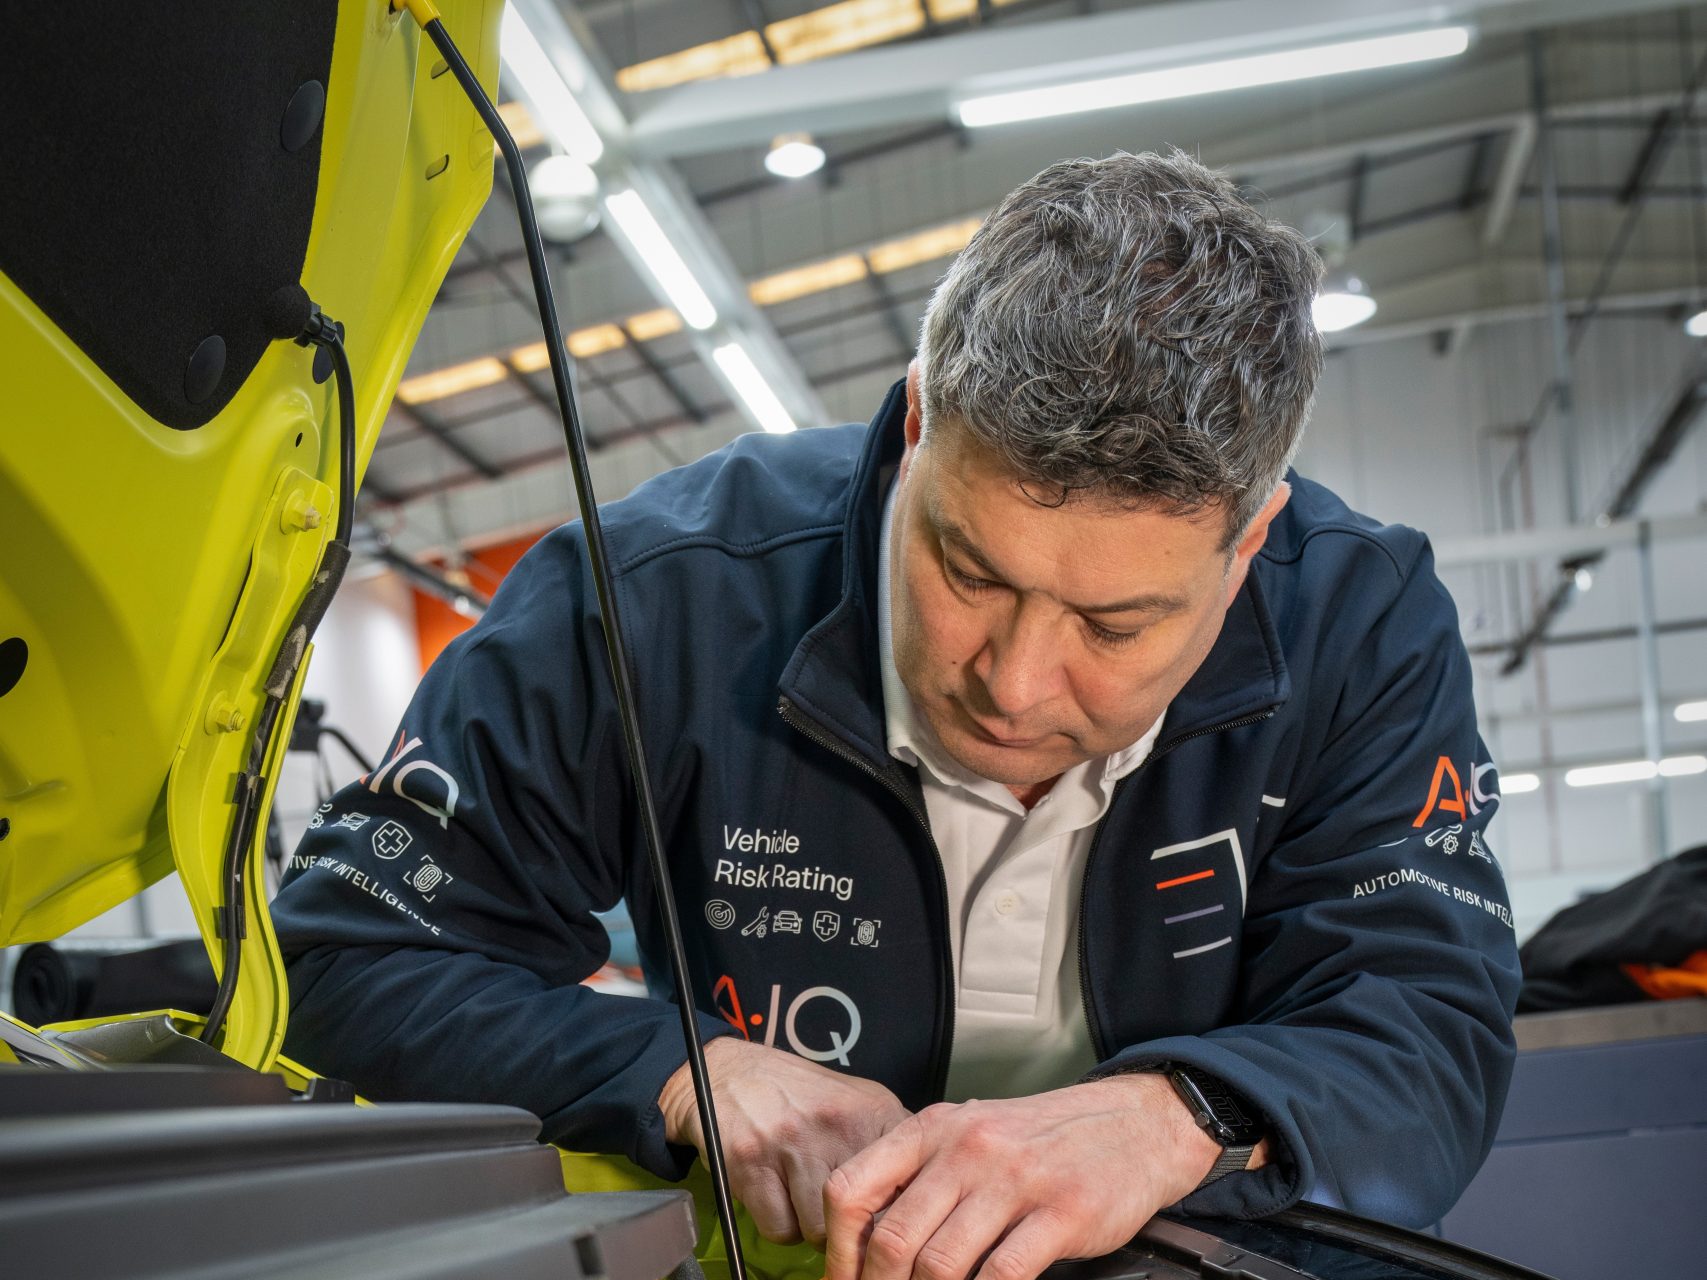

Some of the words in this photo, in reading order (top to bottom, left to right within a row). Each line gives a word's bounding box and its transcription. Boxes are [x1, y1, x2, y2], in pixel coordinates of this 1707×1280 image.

[723, 825, 800, 854] Vehicle
[714, 859, 768, 888] Risk
[771, 864, 853, 901] Rating
[1353, 868, 1450, 899] AUTOMOTIVE
[1453, 886, 1482, 908] RISK
